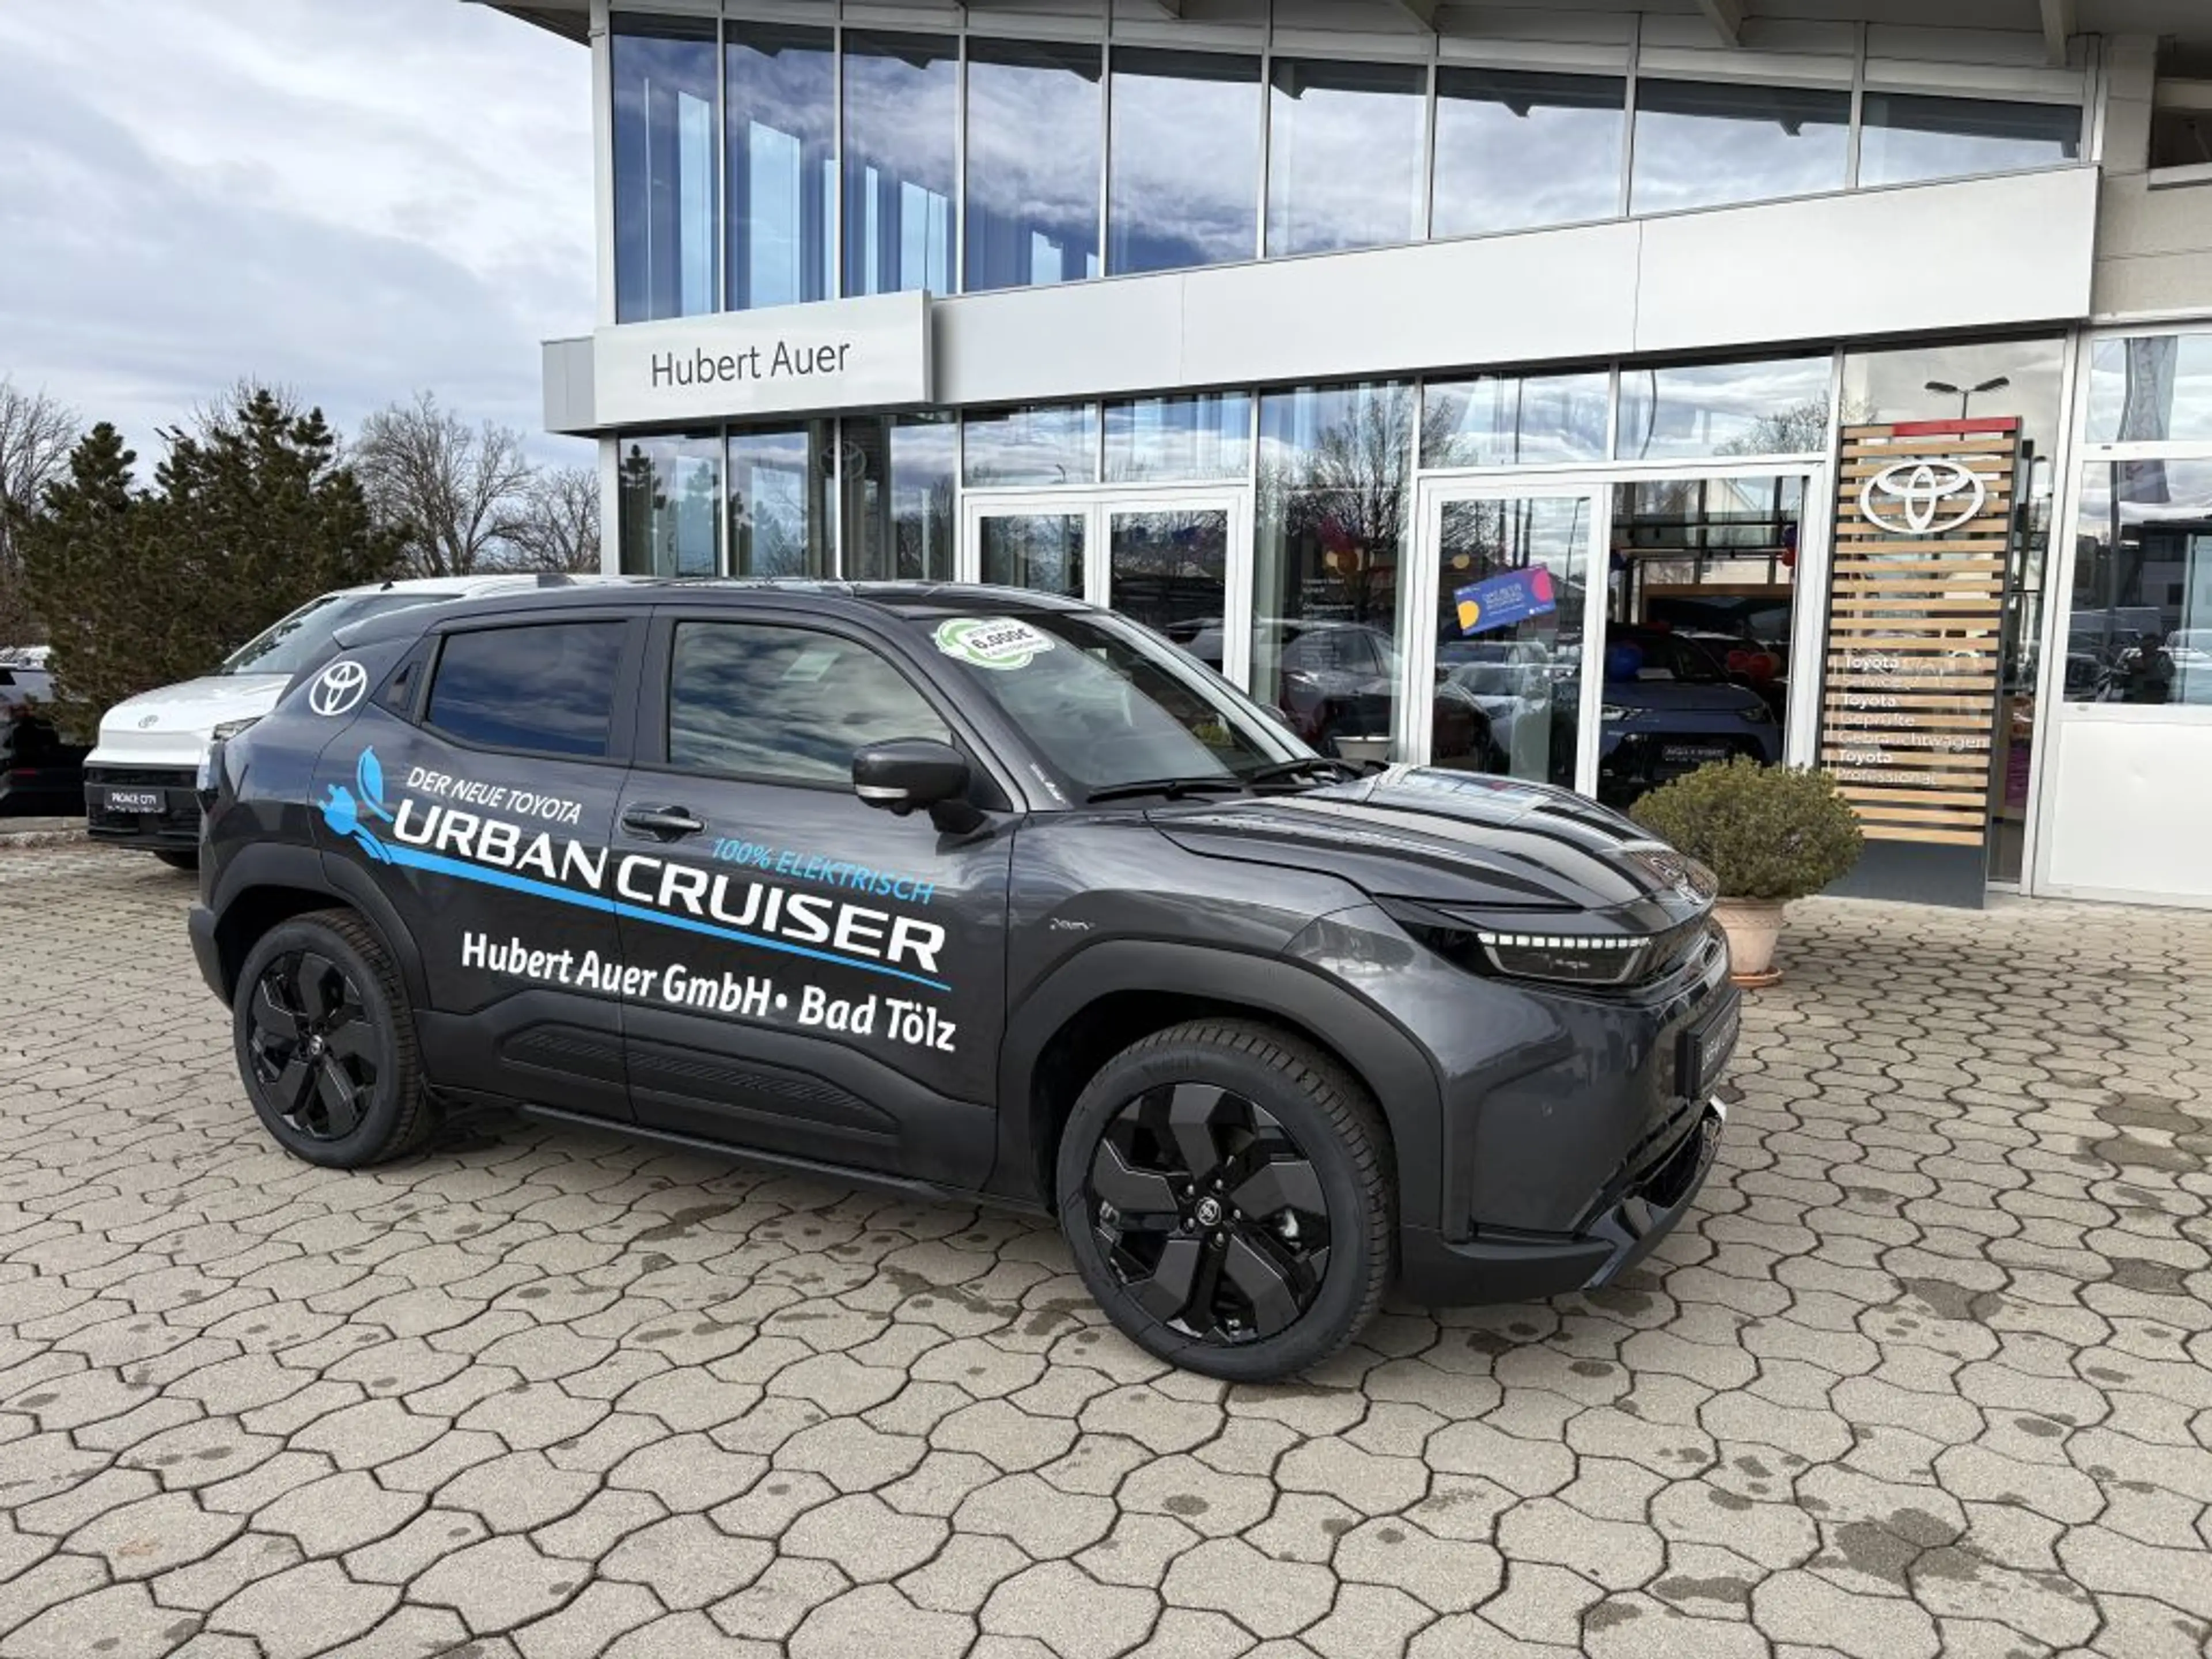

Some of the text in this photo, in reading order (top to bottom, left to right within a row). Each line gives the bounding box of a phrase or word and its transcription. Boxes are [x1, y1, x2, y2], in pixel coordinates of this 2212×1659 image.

[652, 340, 851, 387] Hubert Auer
[1844, 656, 1899, 671] Toyota
[1842, 693, 1897, 709] Toyota
[1838, 749, 1893, 766] Toyota
[406, 767, 582, 825] DER NEUE TOYOTA
[392, 798, 946, 973] URBAN CRUISER
[712, 837, 935, 905] 100% ELEKTRISCH
[461, 931, 574, 984] Hubert
[576, 950, 657, 997] Auer
[798, 984, 877, 1035] Bad
[885, 997, 956, 1052] Tölz
